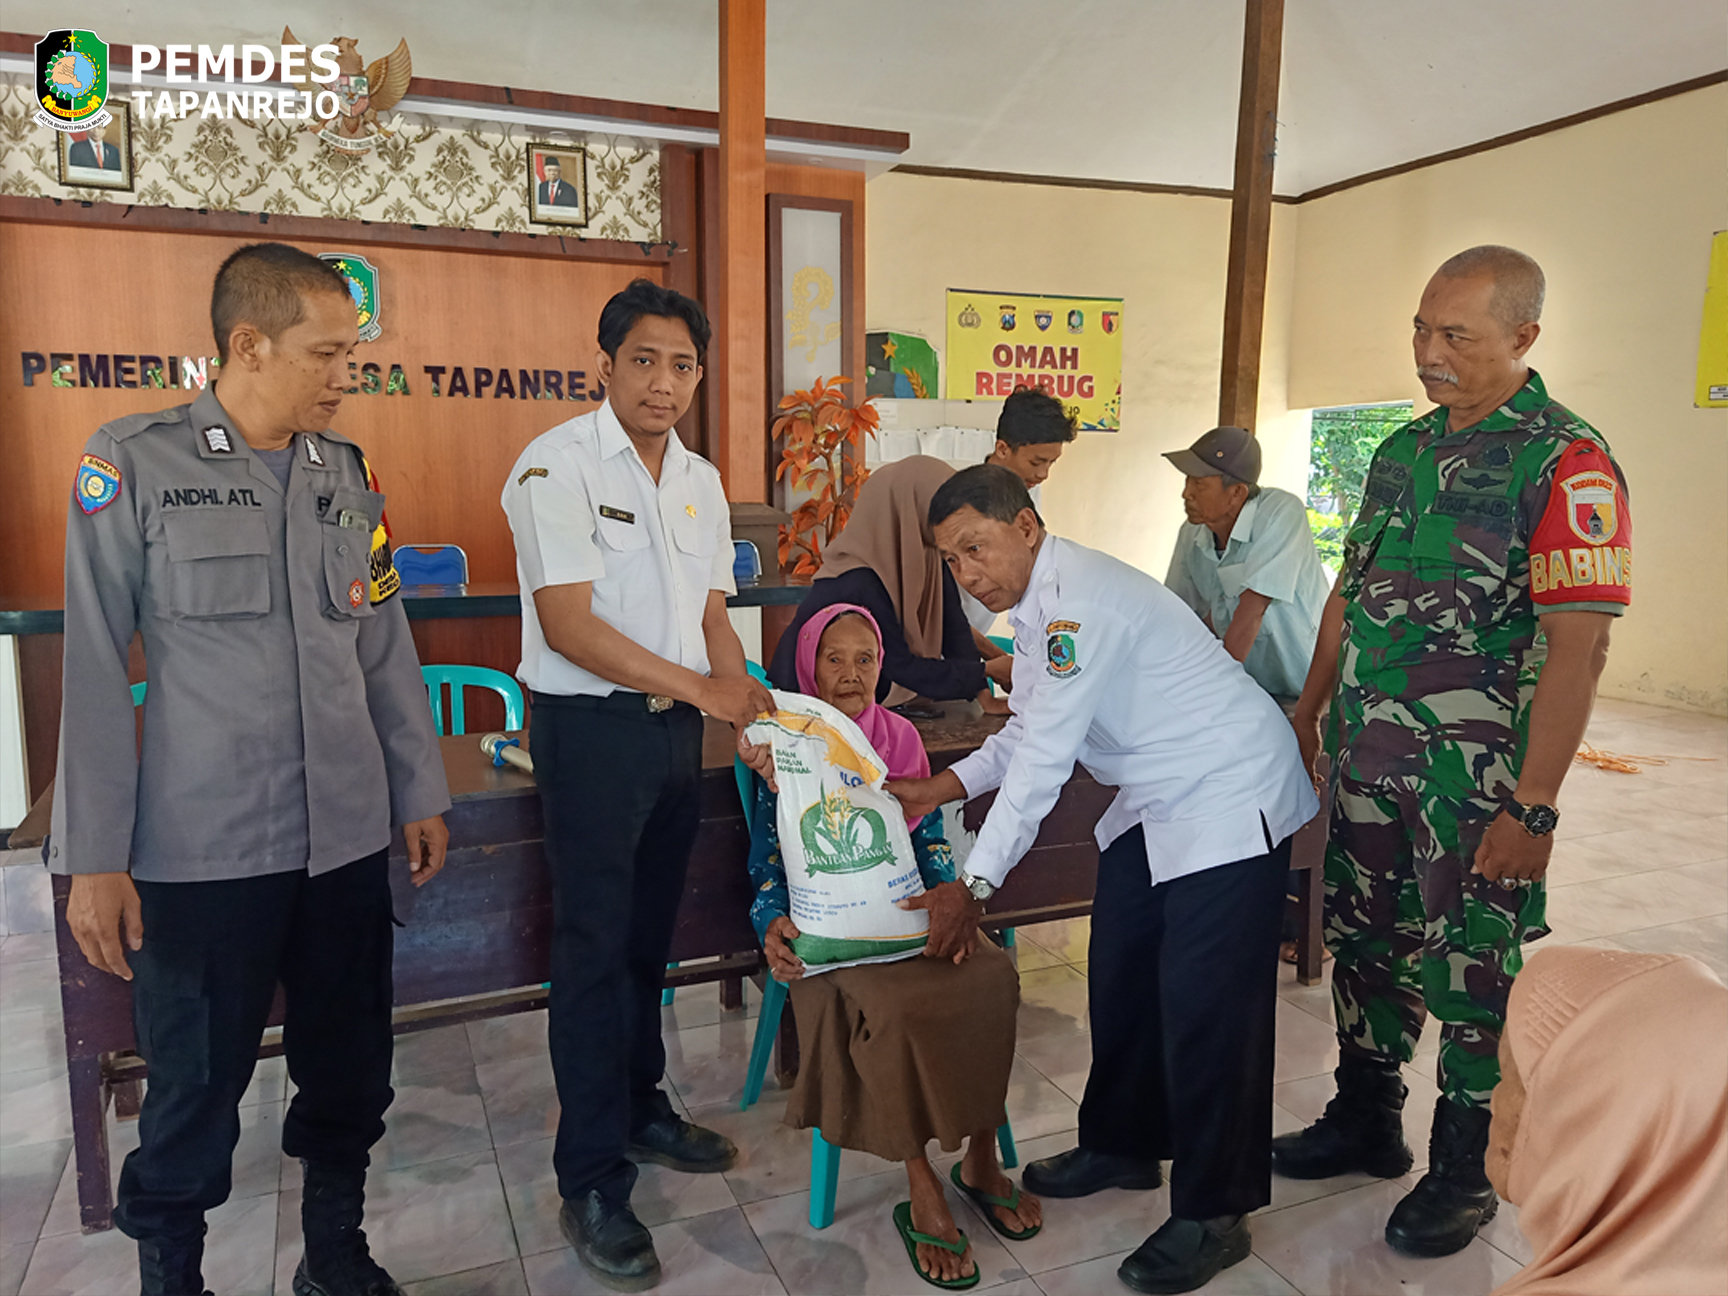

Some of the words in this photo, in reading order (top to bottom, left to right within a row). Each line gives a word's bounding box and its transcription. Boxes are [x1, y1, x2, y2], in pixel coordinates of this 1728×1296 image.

[992, 343, 1079, 370] OMAH
[21, 351, 220, 390] PEMERIN
[342, 362, 411, 396] ESA
[424, 365, 605, 402] TAPANREJ
[975, 371, 1094, 399] REMBUG
[161, 488, 223, 508] ANDHI.
[227, 488, 262, 507] ATL
[1530, 546, 1632, 594] BABINS
